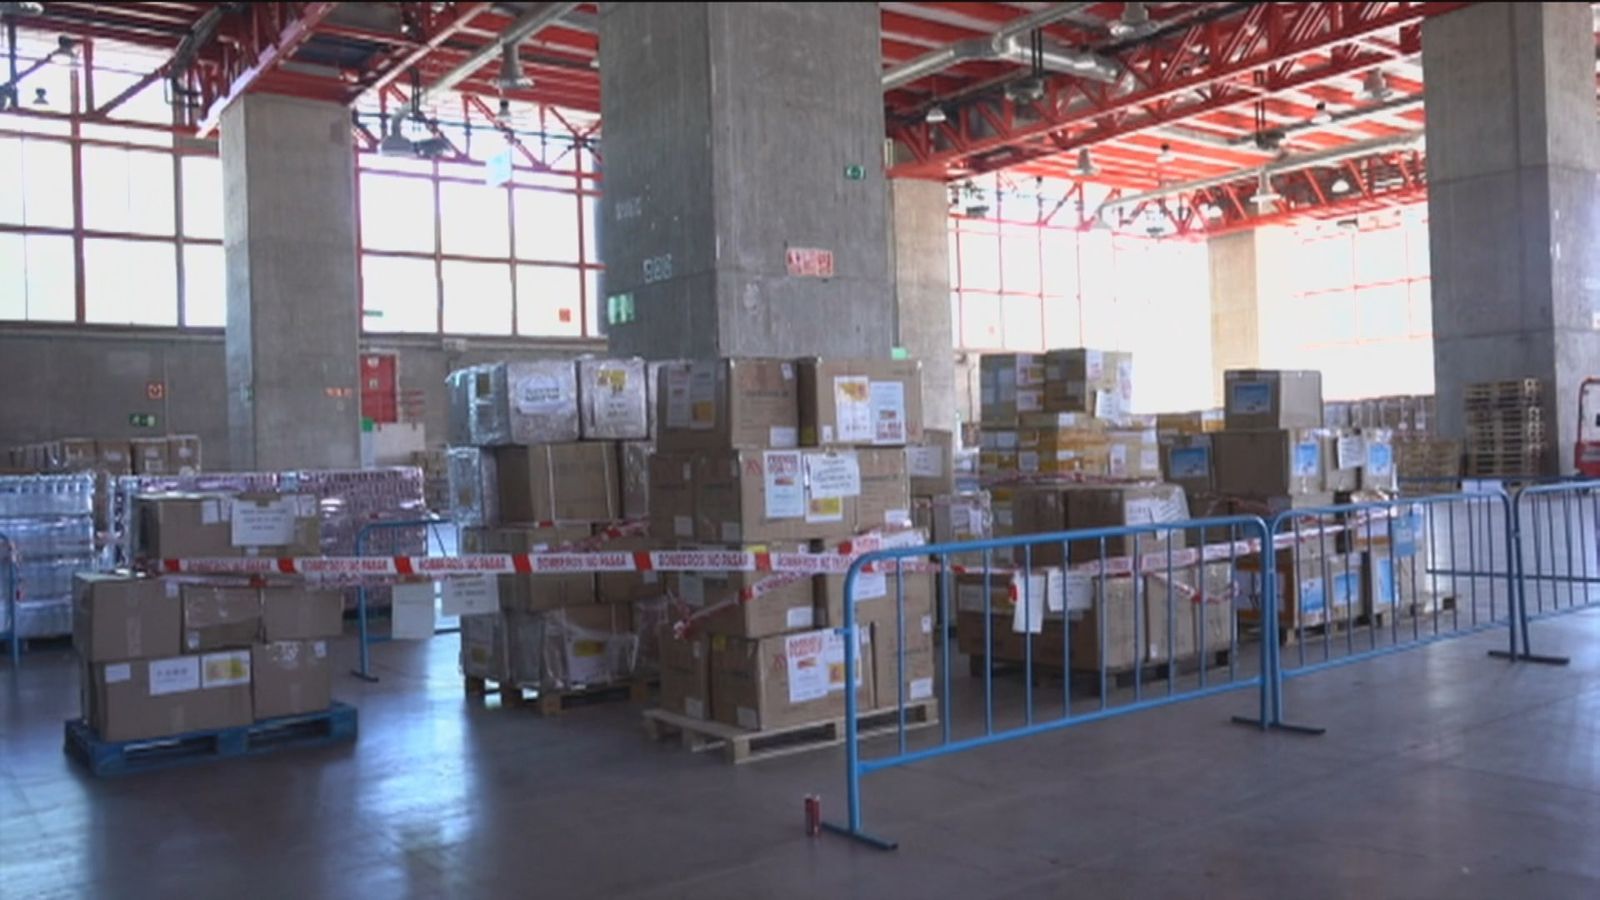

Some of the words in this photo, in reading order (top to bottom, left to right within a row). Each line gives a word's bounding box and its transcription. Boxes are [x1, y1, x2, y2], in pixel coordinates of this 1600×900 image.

[479, 557, 505, 569] PASAR
[537, 557, 582, 569] BOMBEROS
[600, 555, 625, 566] PASAR
[658, 554, 704, 567] BOMBEROS
[721, 554, 747, 567] PASAR
